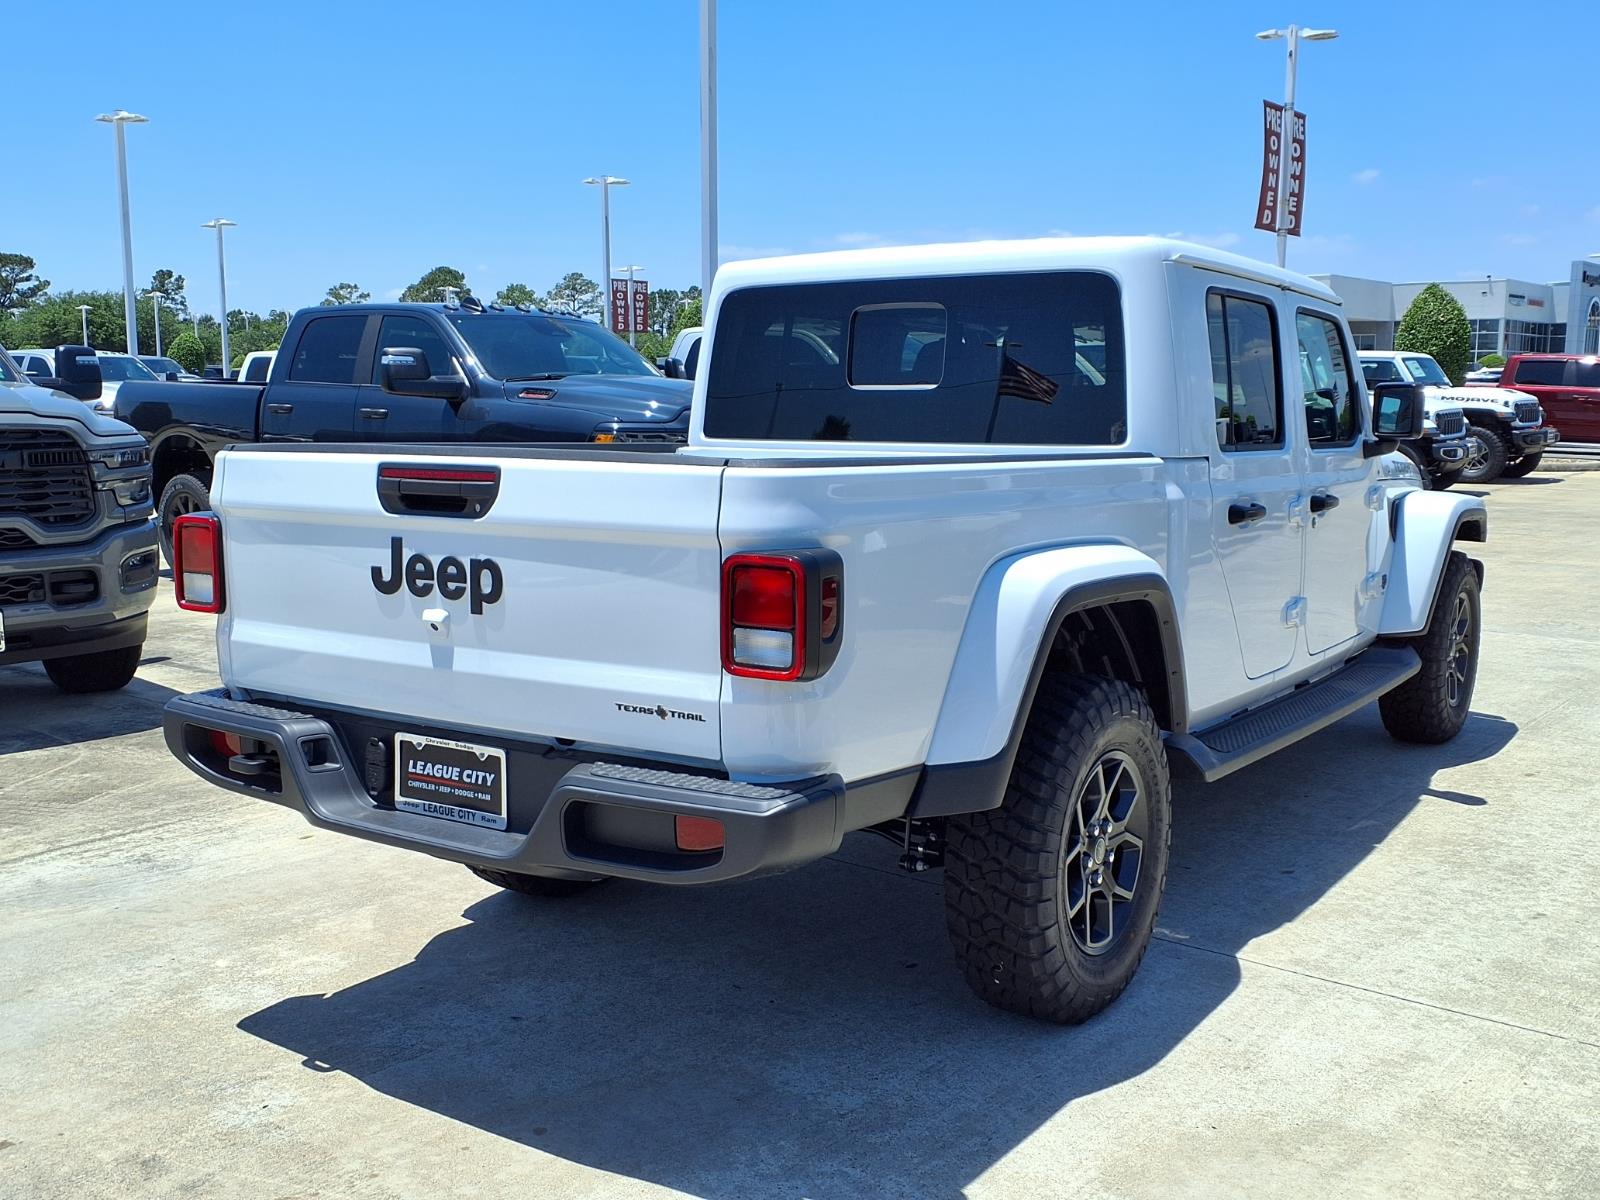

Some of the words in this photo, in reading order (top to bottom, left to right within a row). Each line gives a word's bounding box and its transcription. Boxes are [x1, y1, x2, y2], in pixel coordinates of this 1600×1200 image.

[1266, 107, 1280, 132] PRE
[1293, 118, 1304, 140] RE
[1262, 136, 1279, 225] OWNED
[1288, 143, 1301, 229] OWNED
[613, 281, 627, 291] PRE
[634, 283, 646, 292] PRE
[616, 292, 625, 330] OWNED
[635, 294, 644, 330] OWNED
[371, 536, 503, 615] Jeep
[615, 703, 654, 715] TEXAS
[668, 710, 706, 722] TRAIL
[425, 738, 450, 747] Chrysler
[408, 760, 460, 780] LEAGUE
[463, 769, 494, 786] CITY
[408, 781, 435, 790] CHRYSLER
[455, 789, 474, 798] DODGE
[403, 800, 419, 809] Jeep
[423, 803, 455, 817] LEAGUE
[457, 809, 477, 822] CITY
[481, 816, 497, 824] Ram
